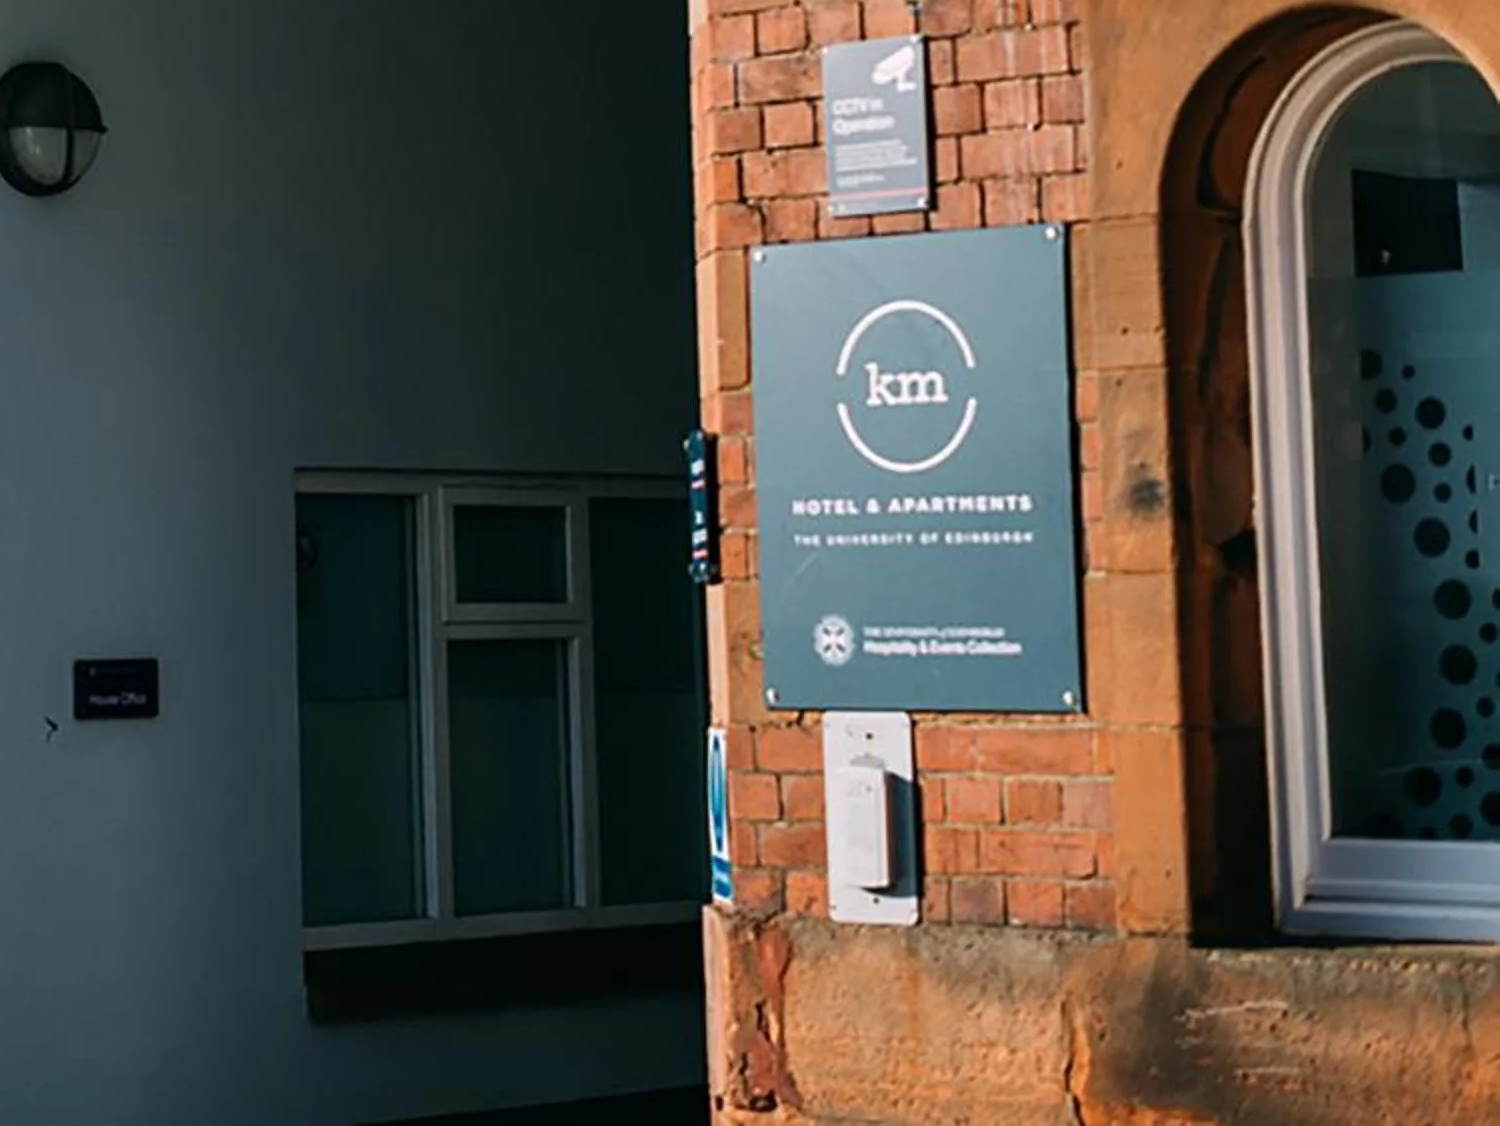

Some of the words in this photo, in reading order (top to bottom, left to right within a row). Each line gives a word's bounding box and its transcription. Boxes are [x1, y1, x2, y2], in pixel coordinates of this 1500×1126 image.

[864, 361, 949, 407] km
[792, 498, 859, 516] HOTEL
[888, 494, 1032, 514] APARTMENTS
